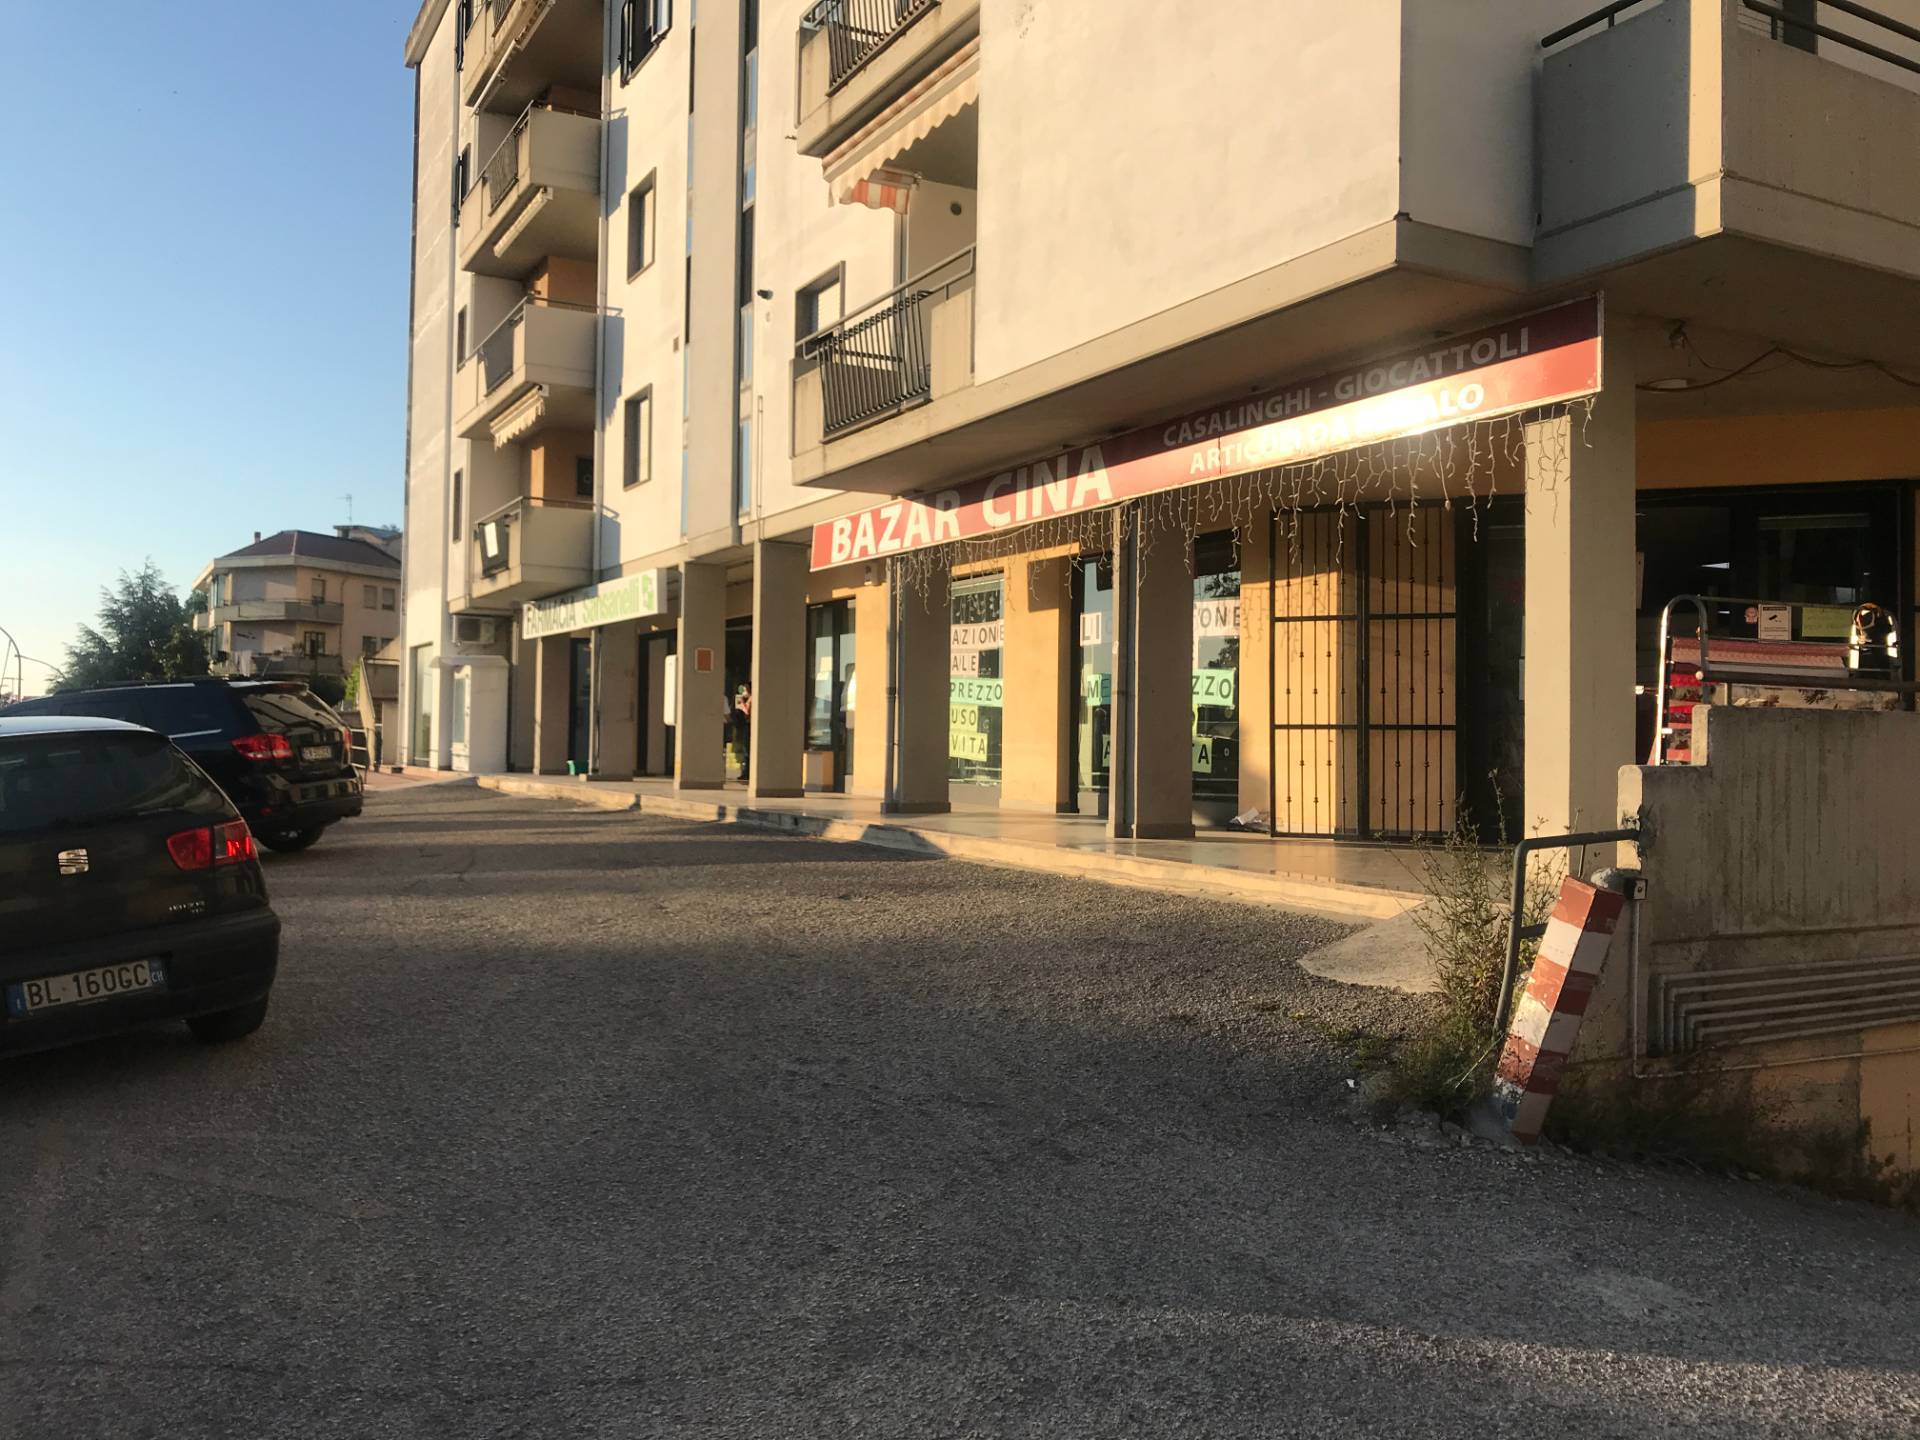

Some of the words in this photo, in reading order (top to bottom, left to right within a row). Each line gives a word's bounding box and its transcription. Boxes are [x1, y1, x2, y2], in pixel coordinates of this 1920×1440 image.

[1163, 387, 1311, 447] CASALINGHI
[1334, 327, 1529, 400] GIOCATTOLI
[831, 490, 961, 564] BAZAR
[982, 446, 1113, 527] CINA
[526, 597, 577, 636] FARMACIA
[952, 655, 977, 671] ALE
[951, 682, 1003, 701] PREZZO
[951, 709, 977, 726] USO
[951, 735, 986, 754] VITA
[26, 980, 61, 1008] BL
